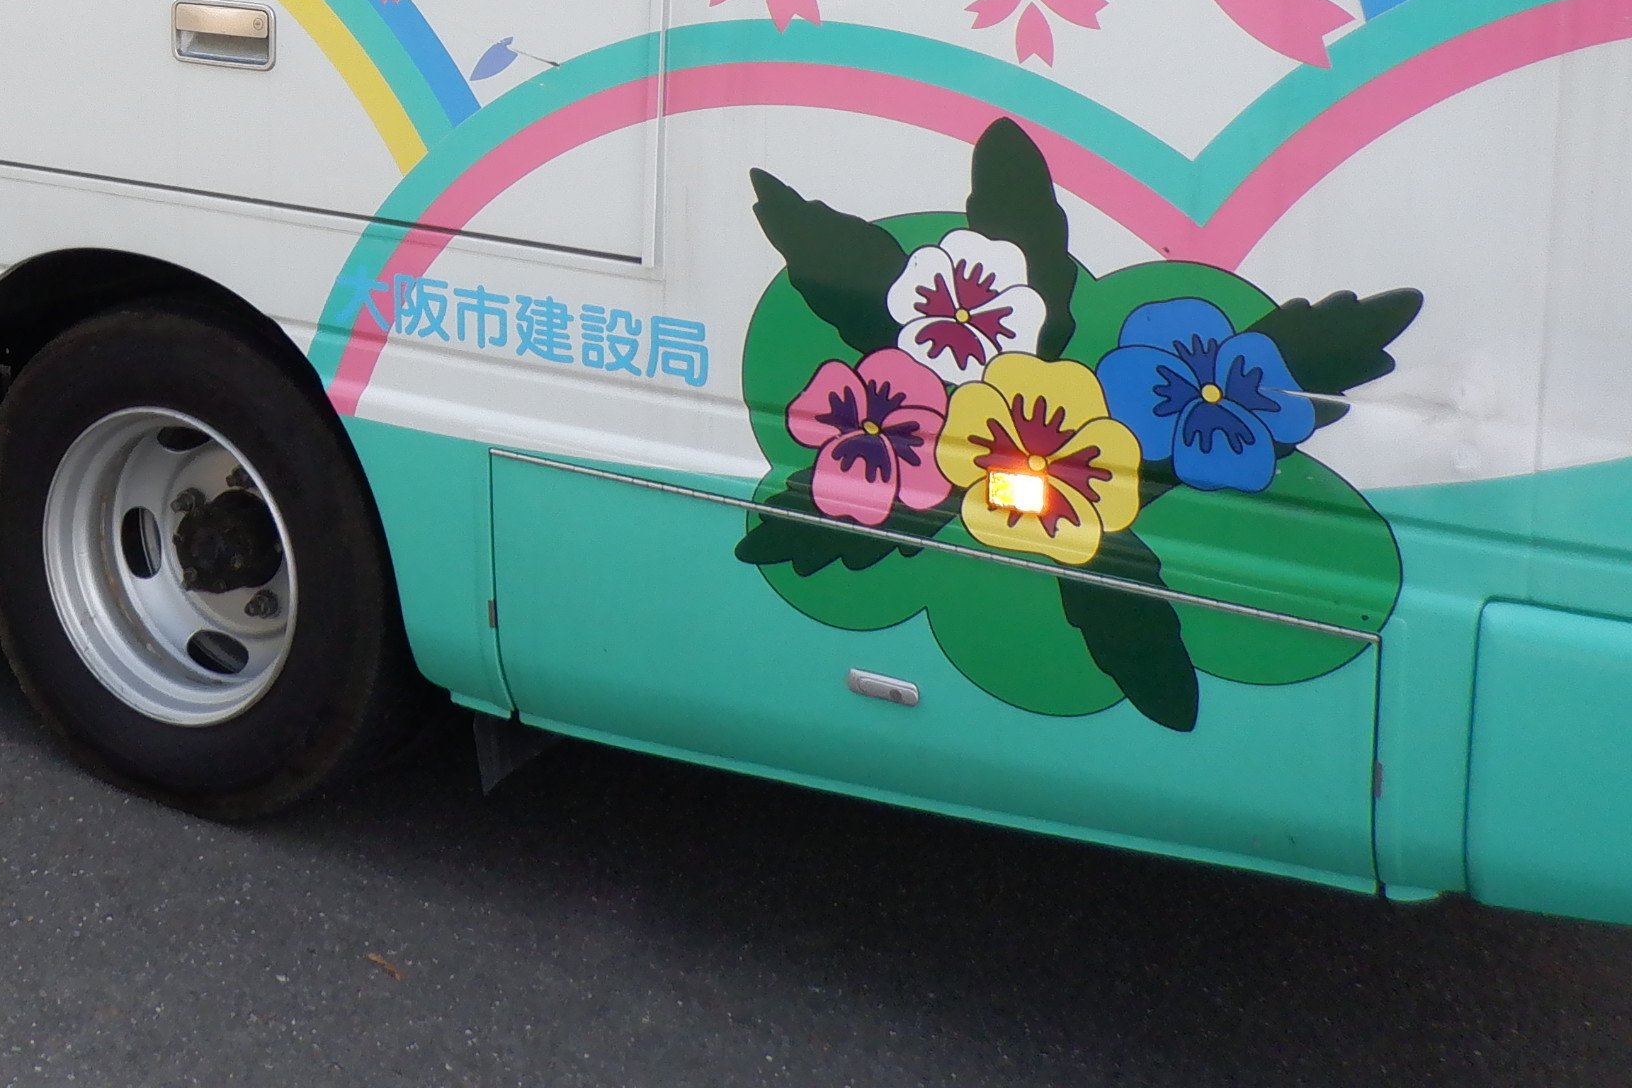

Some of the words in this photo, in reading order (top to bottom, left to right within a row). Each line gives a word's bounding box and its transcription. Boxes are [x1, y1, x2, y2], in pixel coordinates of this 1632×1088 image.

[335, 265, 709, 387] 大阪市建設局
